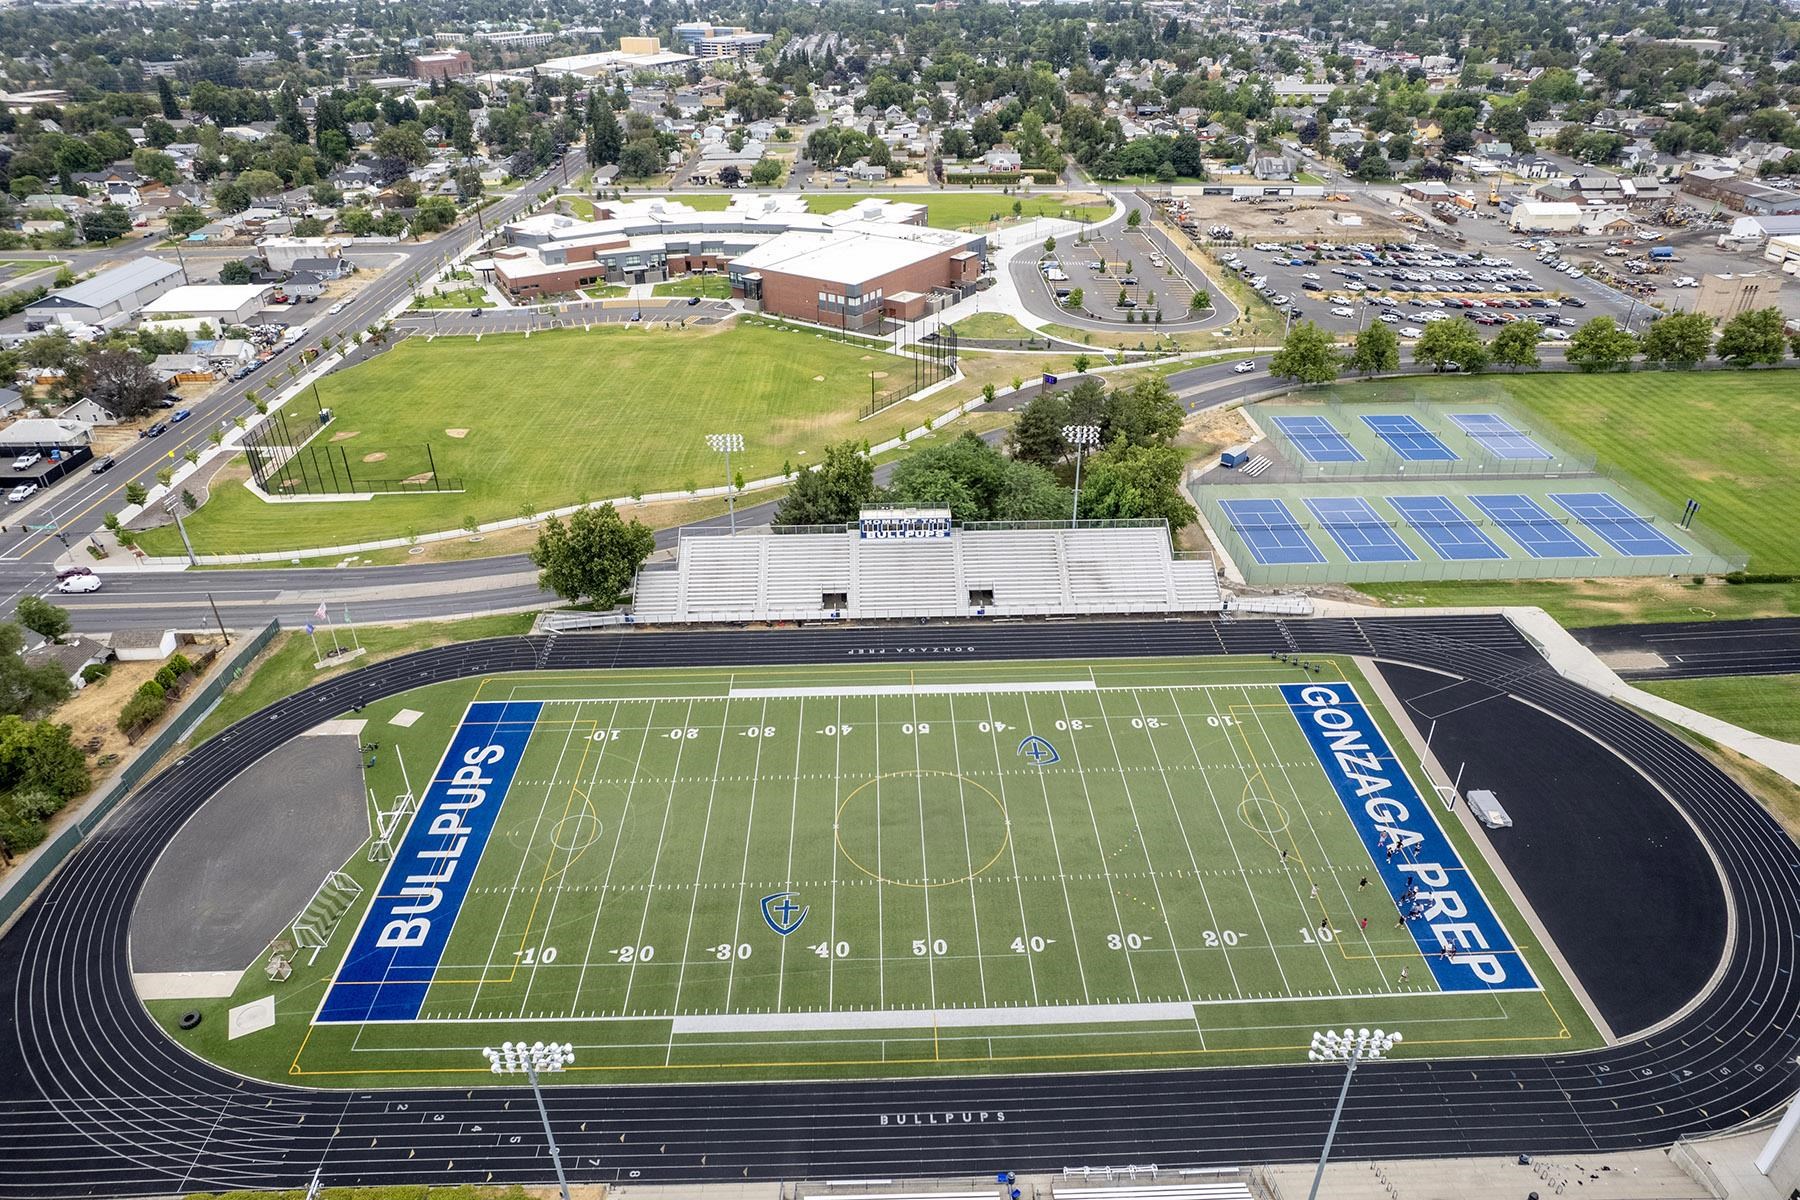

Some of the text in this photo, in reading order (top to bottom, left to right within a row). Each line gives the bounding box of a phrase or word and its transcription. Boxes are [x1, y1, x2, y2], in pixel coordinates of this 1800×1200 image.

[866, 530, 945, 539] BULLPUPS
[978, 722, 1007, 733] 40
[1055, 719, 1084, 731] 30
[1131, 718, 1160, 730] 20
[1207, 716, 1235, 728] 10
[670, 728, 699, 740] 20
[747, 727, 776, 738] 30
[824, 725, 853, 736] 40
[902, 723, 930, 734] 50
[593, 730, 621, 741] 10
[1301, 686, 1506, 984] GONZAGA PREP
[375, 744, 505, 948] BULLPUPS
[1106, 933, 1142, 950] 30
[1202, 930, 1239, 947] 20
[1299, 927, 1334, 944] 10
[814, 941, 850, 958] 40
[912, 939, 948, 956] 50
[1010, 936, 1045, 953] 40
[521, 947, 558, 964] 10
[617, 945, 655, 962] 20
[716, 943, 752, 960] 30
[1642, 1068, 1653, 1076] 3
[1720, 1067, 1732, 1075] 5
[397, 1103, 409, 1111] 2
[880, 1111, 1005, 1126] BULLPUPS
